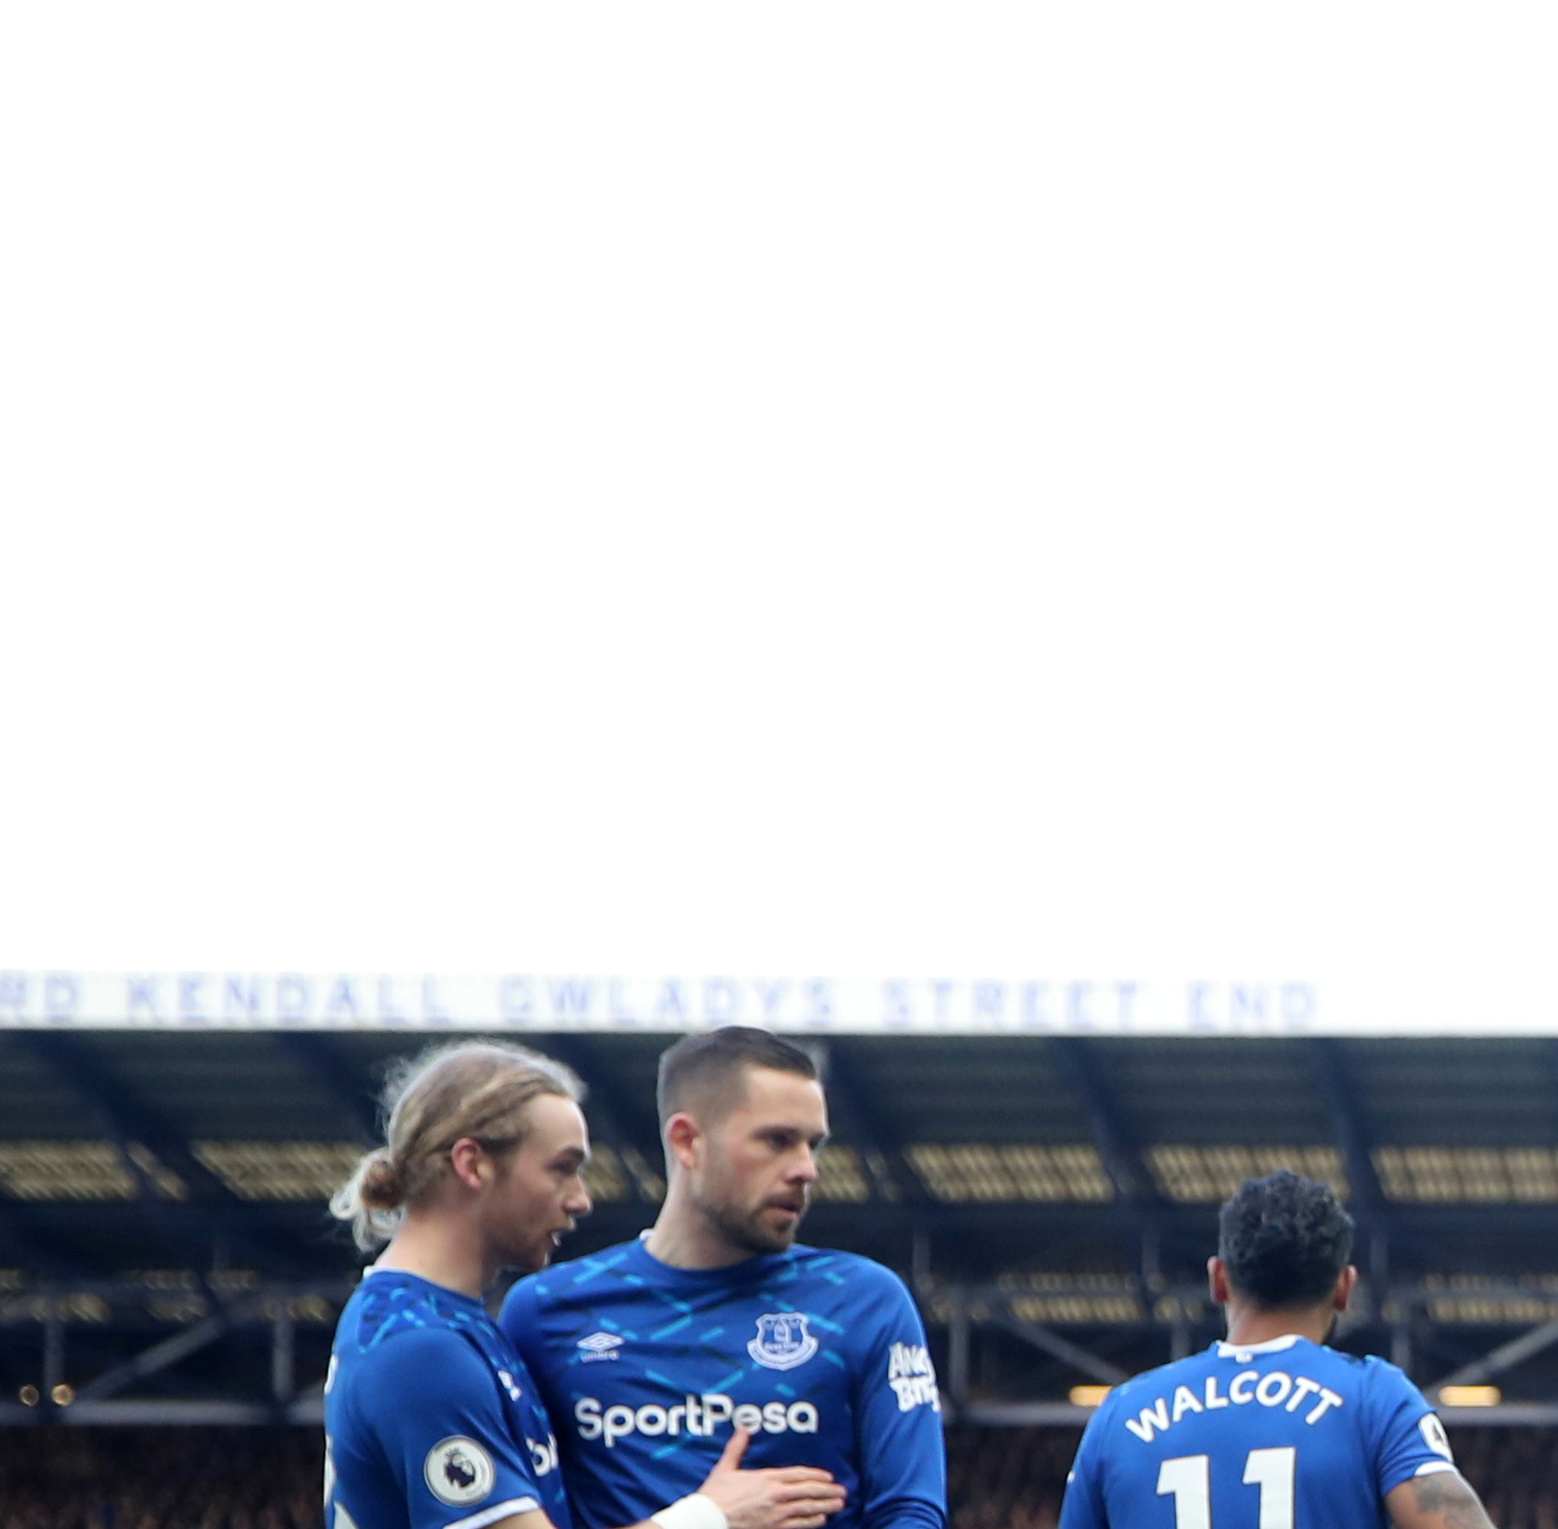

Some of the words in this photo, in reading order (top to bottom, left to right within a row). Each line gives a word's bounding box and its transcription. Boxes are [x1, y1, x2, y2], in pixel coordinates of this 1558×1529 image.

[126, 972, 453, 1026] KENDALL
[498, 974, 838, 1027] GWLADYS
[882, 977, 1139, 1029] STREET
[1186, 979, 1321, 1030] END
[574, 1393, 819, 1448] SportPesa
[1125, 1370, 1344, 1443] WALCOTT
